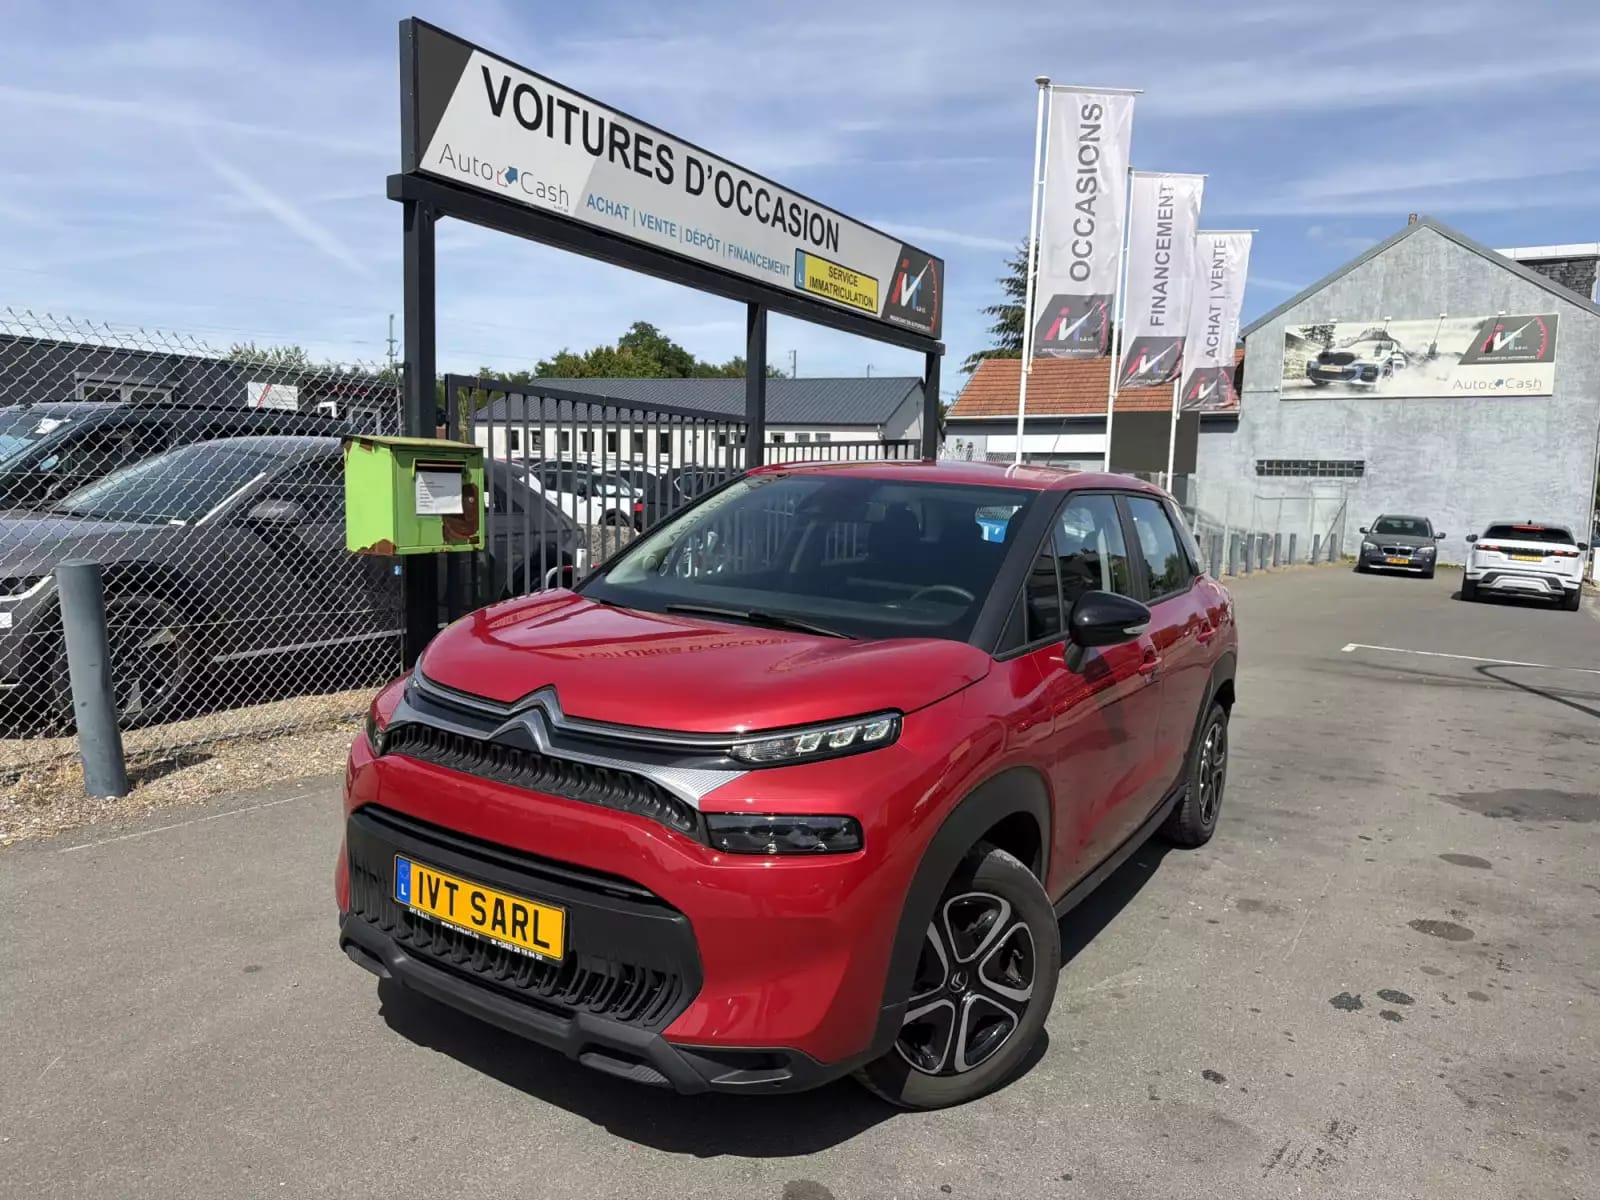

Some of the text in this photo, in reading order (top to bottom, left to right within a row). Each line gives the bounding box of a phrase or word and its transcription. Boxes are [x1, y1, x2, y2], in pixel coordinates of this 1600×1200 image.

[438, 143, 569, 206] Auto Cash
[481, 65, 839, 253] VOITURES D'OCCASION
[1069, 103, 1103, 282] OCCASIONS
[586, 192, 790, 276] ACHAT VENTE DÉPÔT FINANCEMENT
[1150, 183, 1175, 327] FINANCEMENT
[809, 276, 873, 309] IMMATRICULATION
[828, 265, 858, 287] SERVICE
[1205, 239, 1226, 359] ACHAT VENTE
[1505, 378, 1541, 389] Cash
[401, 871, 550, 949] L IVT SARL
